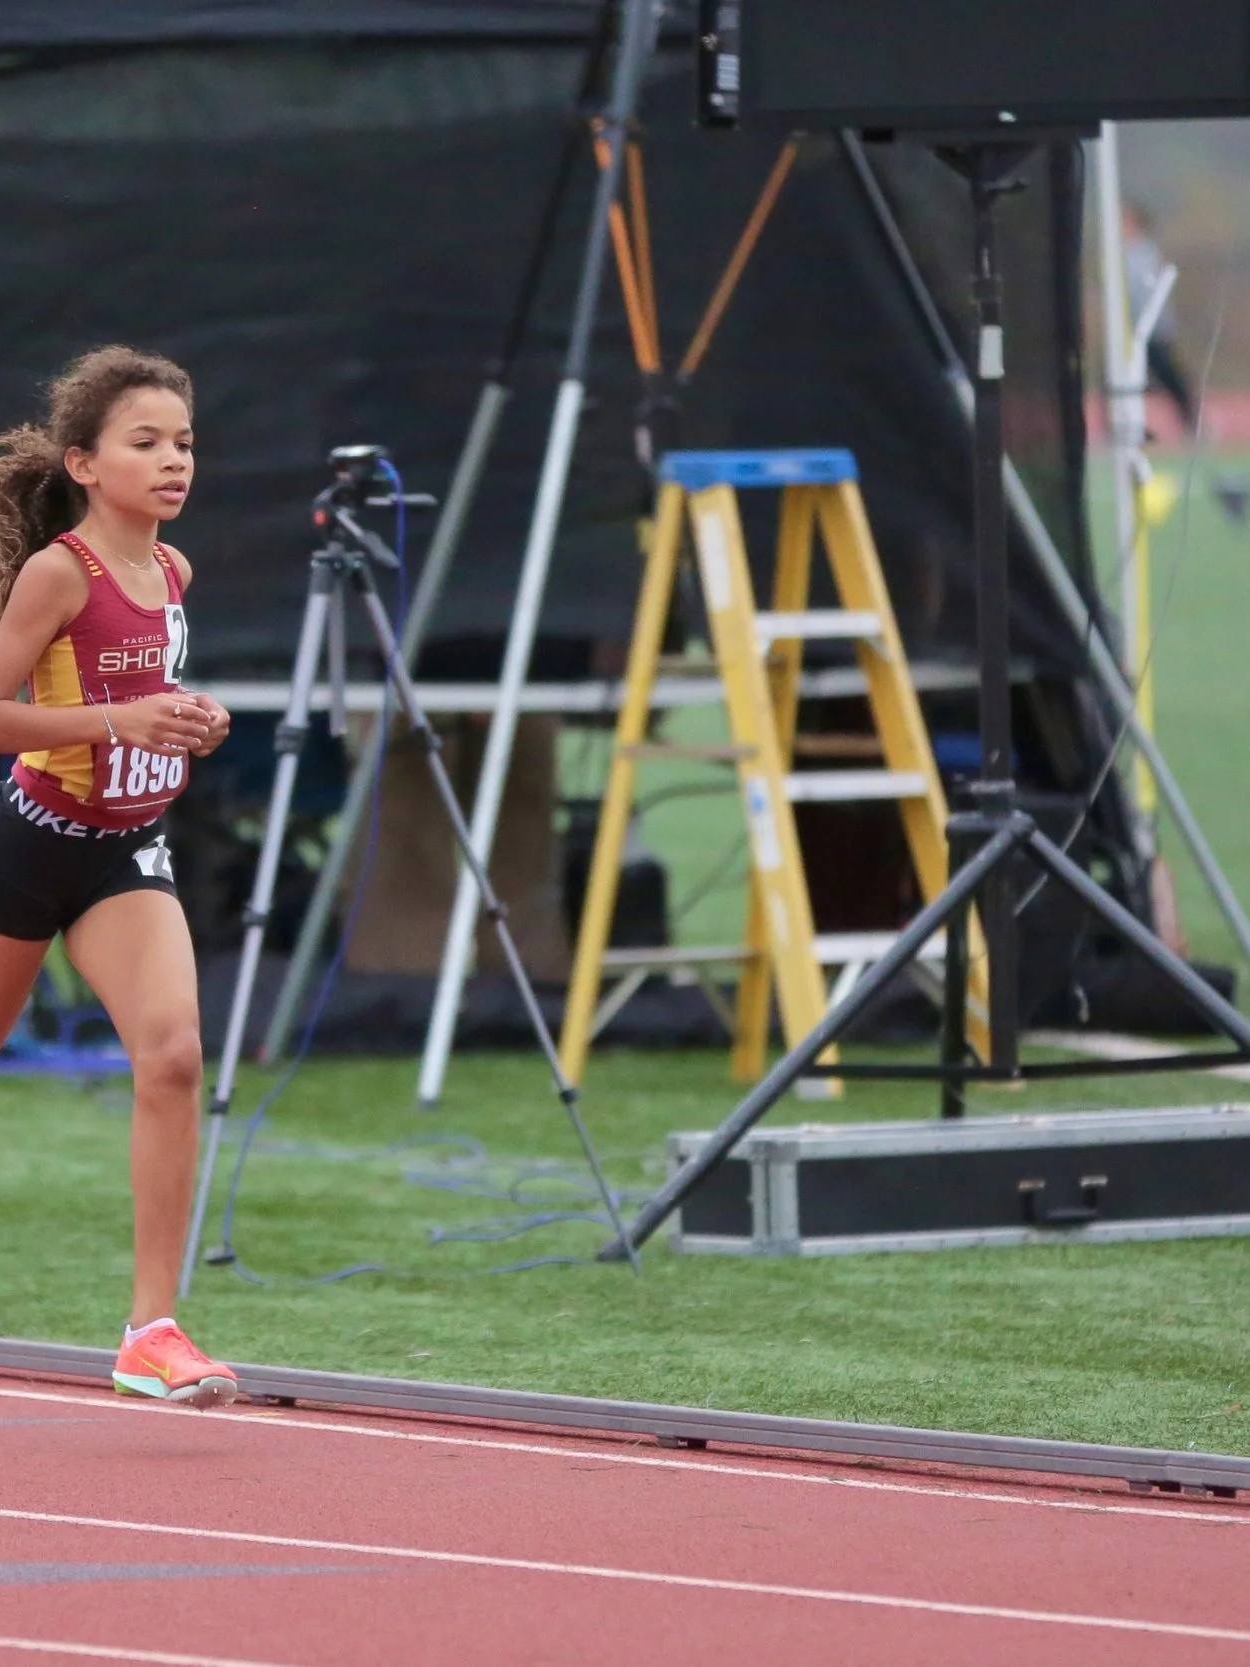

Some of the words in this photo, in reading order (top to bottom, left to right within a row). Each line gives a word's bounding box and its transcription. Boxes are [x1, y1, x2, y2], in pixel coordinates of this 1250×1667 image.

[123, 634, 163, 645] PACIFIC
[103, 746, 183, 798] 1898
[9, 787, 88, 838] NIKE
